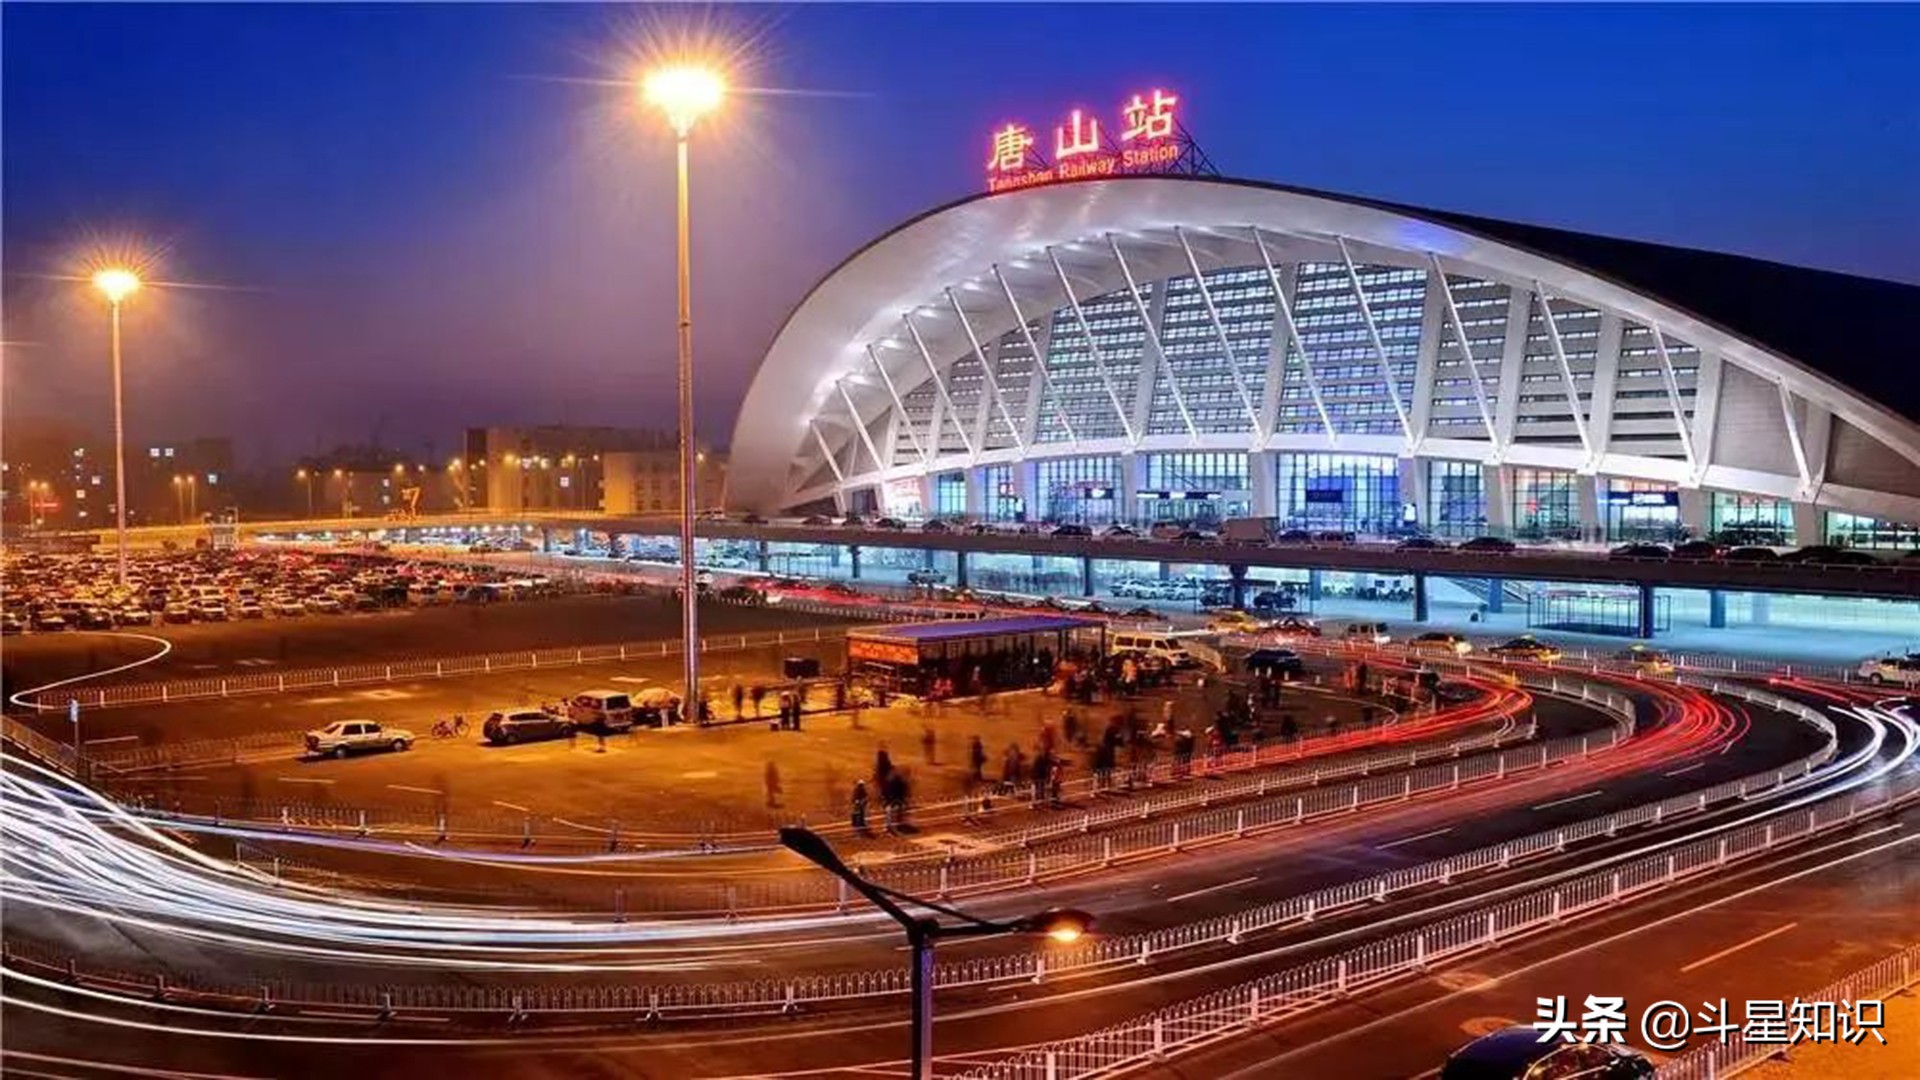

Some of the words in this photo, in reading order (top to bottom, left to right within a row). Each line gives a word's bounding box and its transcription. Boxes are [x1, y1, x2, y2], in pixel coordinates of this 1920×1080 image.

[988, 89, 1177, 170] 唐山站
[1059, 156, 1115, 179] Railway
[1123, 144, 1179, 168] Station
